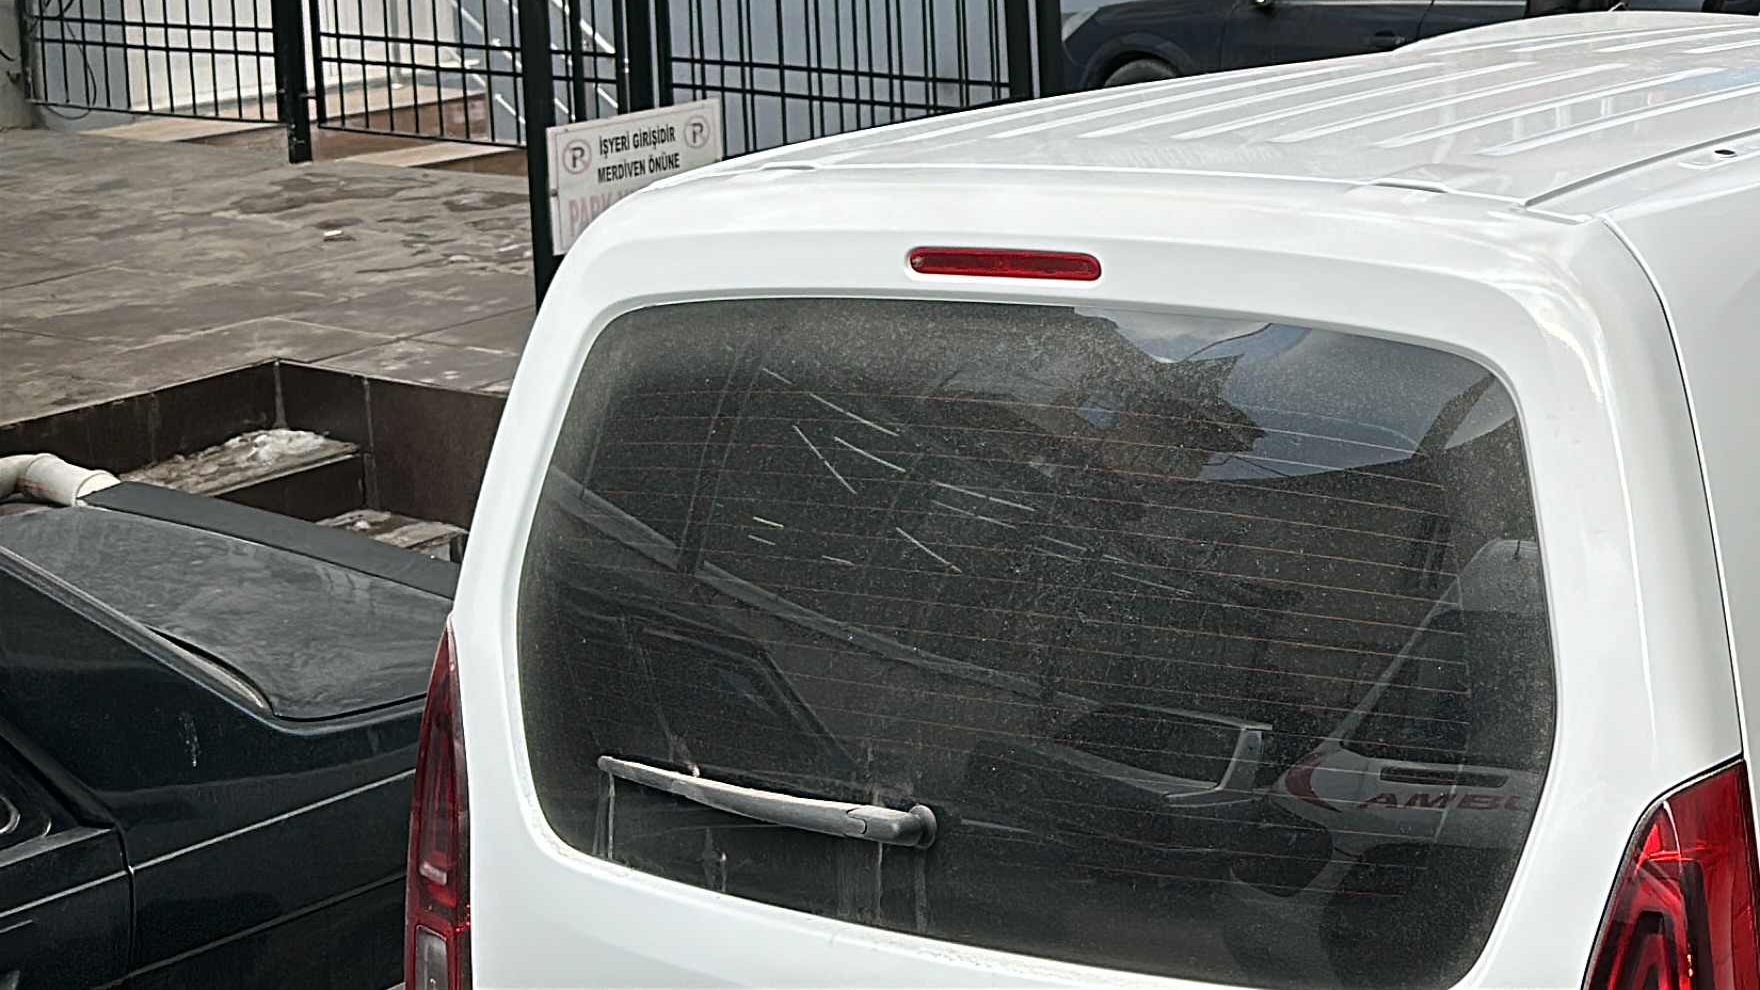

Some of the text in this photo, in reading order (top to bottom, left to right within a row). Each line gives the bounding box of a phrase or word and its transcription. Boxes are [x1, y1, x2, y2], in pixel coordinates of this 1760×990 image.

[599, 124, 676, 159] İŞYERİ GİRİŞİDİR
[597, 152, 681, 184] MERDİVEN ÖNÜNE
